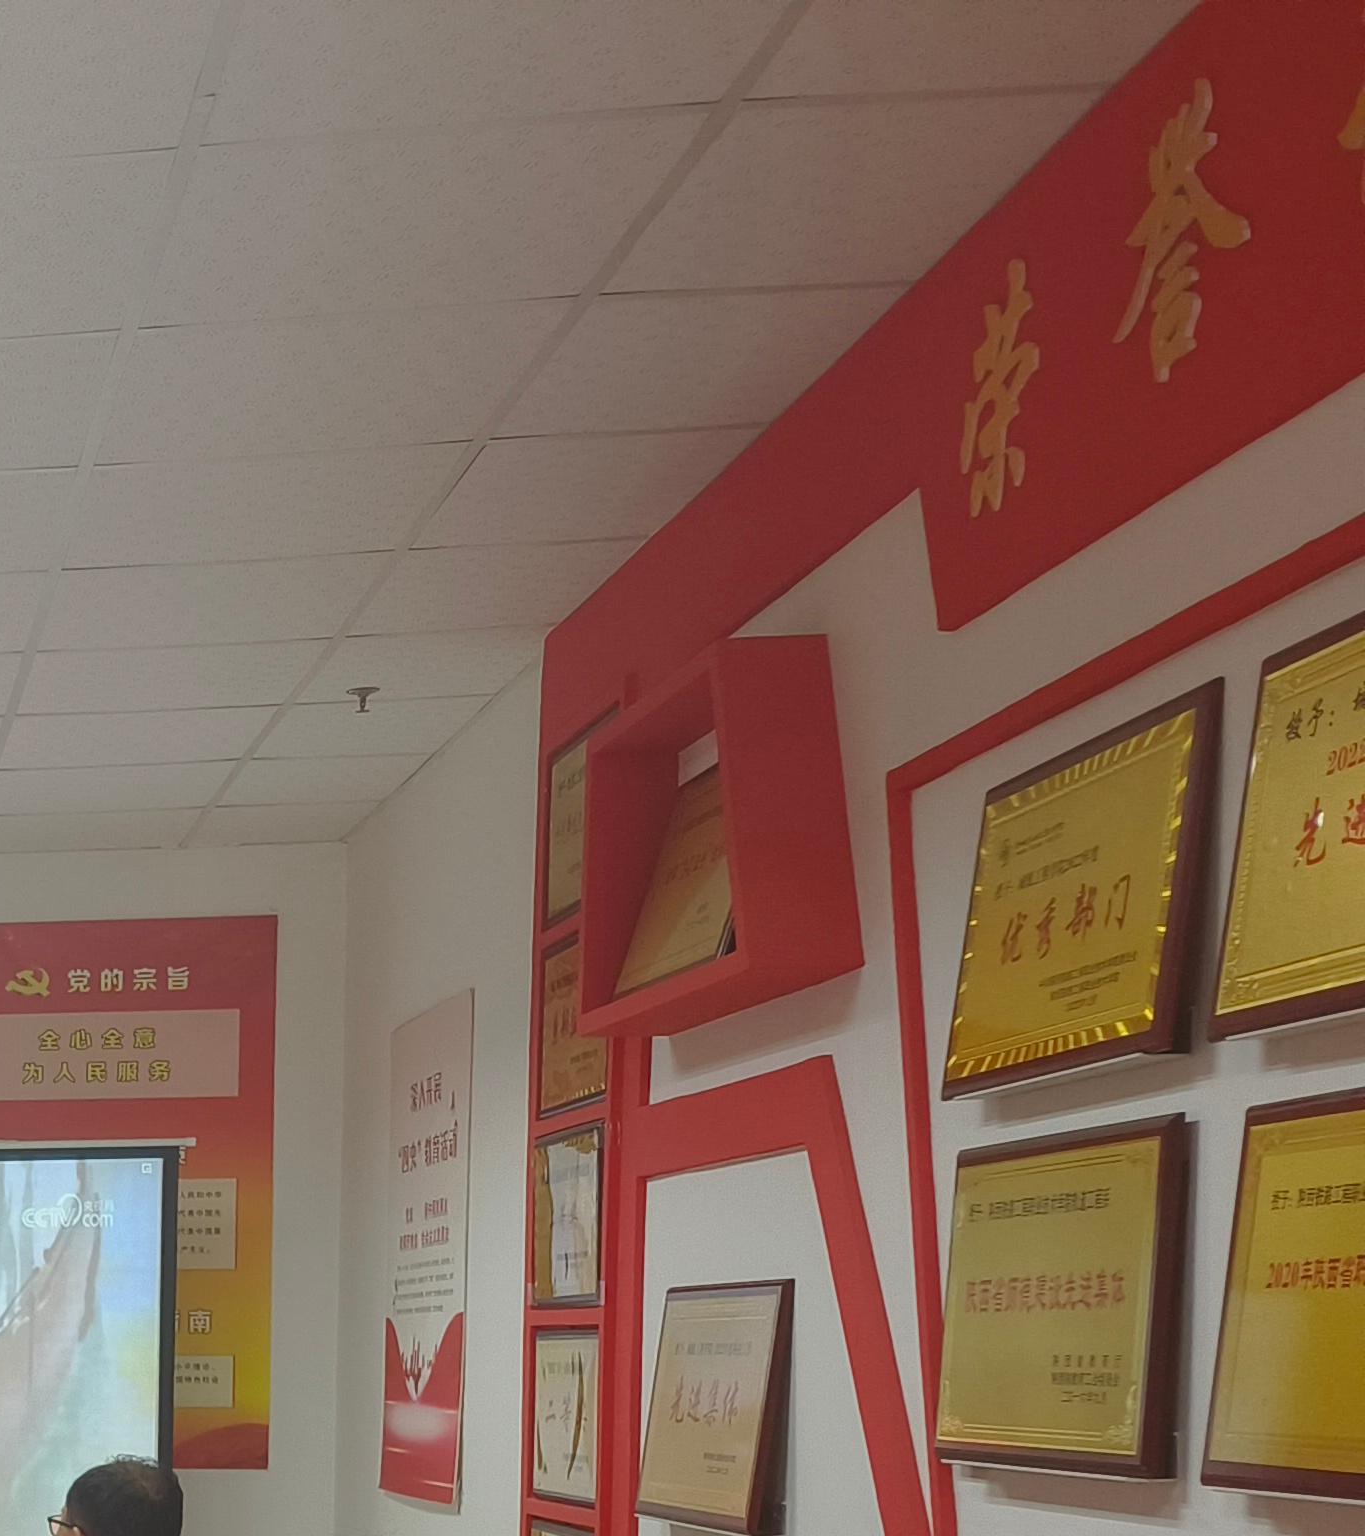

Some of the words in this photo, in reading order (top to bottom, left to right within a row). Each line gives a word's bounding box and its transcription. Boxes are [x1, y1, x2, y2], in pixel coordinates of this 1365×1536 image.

[960, 78, 1365, 518] 荣誉
[67, 966, 190, 994] 党的宗旨
[38, 1027, 157, 1052] 全心全意
[22, 1060, 172, 1085] 为人民服务
[174, 1309, 212, 1334] 南
